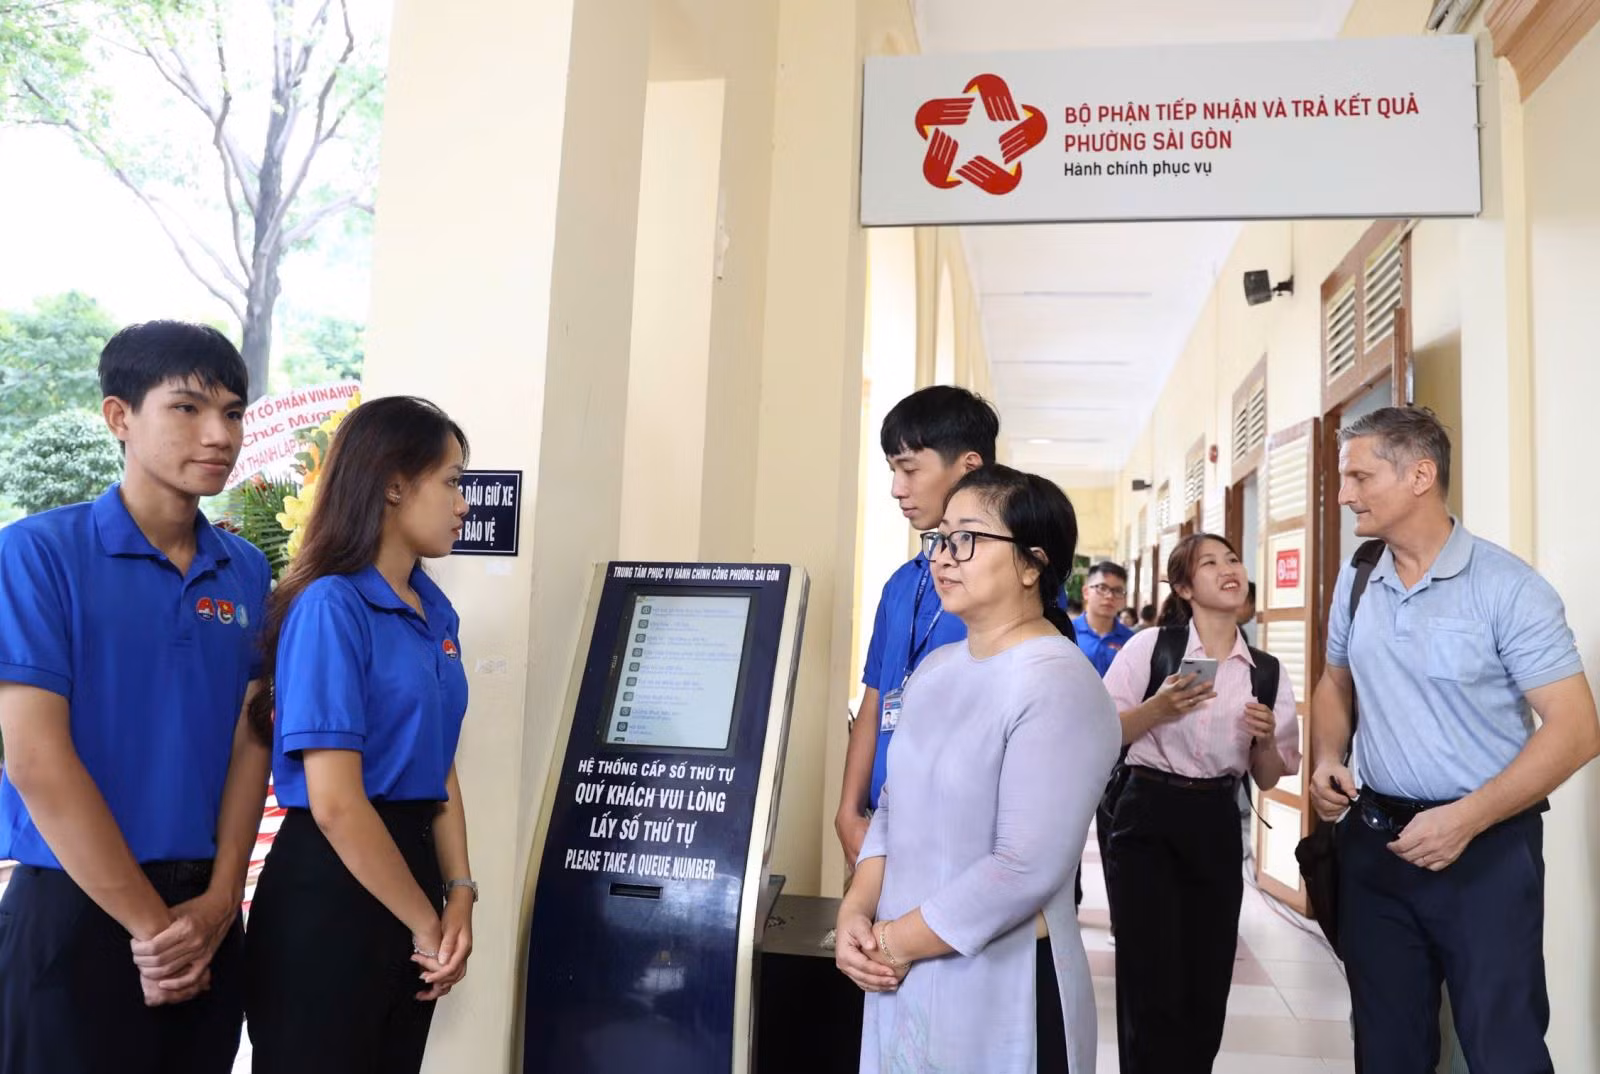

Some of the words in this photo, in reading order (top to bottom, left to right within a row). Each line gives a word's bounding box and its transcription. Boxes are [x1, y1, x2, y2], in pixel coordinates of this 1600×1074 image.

[1065, 102, 1091, 127] BỘ
[1098, 101, 1150, 126] PHẬN
[1156, 98, 1197, 121] TIẾP
[1203, 98, 1256, 123] NHẬN
[1262, 97, 1287, 118] VÀ
[1291, 94, 1329, 118] TRẢ
[1334, 93, 1371, 116] KẾT
[1377, 92, 1419, 119] QUẢ
[1064, 130, 1146, 152] PHƯỜNG
[1153, 128, 1184, 150] SÀI
[1191, 127, 1232, 149] GÒN
[1064, 162, 1102, 176] Hành
[1106, 161, 1148, 176] chính
[1153, 160, 1190, 177] phục
[1194, 162, 1212, 176] vụ
[485, 481, 502, 506] GIỮ
[502, 485, 514, 506] XE
[464, 514, 482, 542] BẢO
[485, 517, 496, 547] VỆ
[613, 566, 633, 578] TRUNG
[647, 567, 665, 581] PHỤC
[665, 567, 674, 582] VỤ
[674, 565, 692, 580] HÀNH
[691, 565, 712, 580] CHÍNH
[711, 566, 729, 580] CÔNG
[755, 567, 766, 581] SÀI
[766, 568, 780, 581] GÒN
[578, 757, 595, 776] HỆ
[598, 757, 637, 776] THỐNG
[641, 760, 666, 777] CẤP
[669, 761, 688, 779] SỐ
[689, 764, 716, 781] THỨ
[718, 767, 736, 785] TỰ
[575, 779, 606, 805] QUÝ
[606, 781, 656, 808] KHÁCH
[659, 788, 685, 810] VUI
[687, 786, 726, 813] LÒNG
[589, 811, 618, 839] LẤY
[619, 813, 643, 841] SỐ
[643, 817, 675, 843] THỨ
[676, 821, 698, 849] TỰ
[565, 849, 602, 872] PLEASE
[602, 852, 626, 873] TAKE
[627, 853, 636, 874] A
[638, 854, 671, 878] QUEUE
[672, 856, 716, 881] NUMBER
